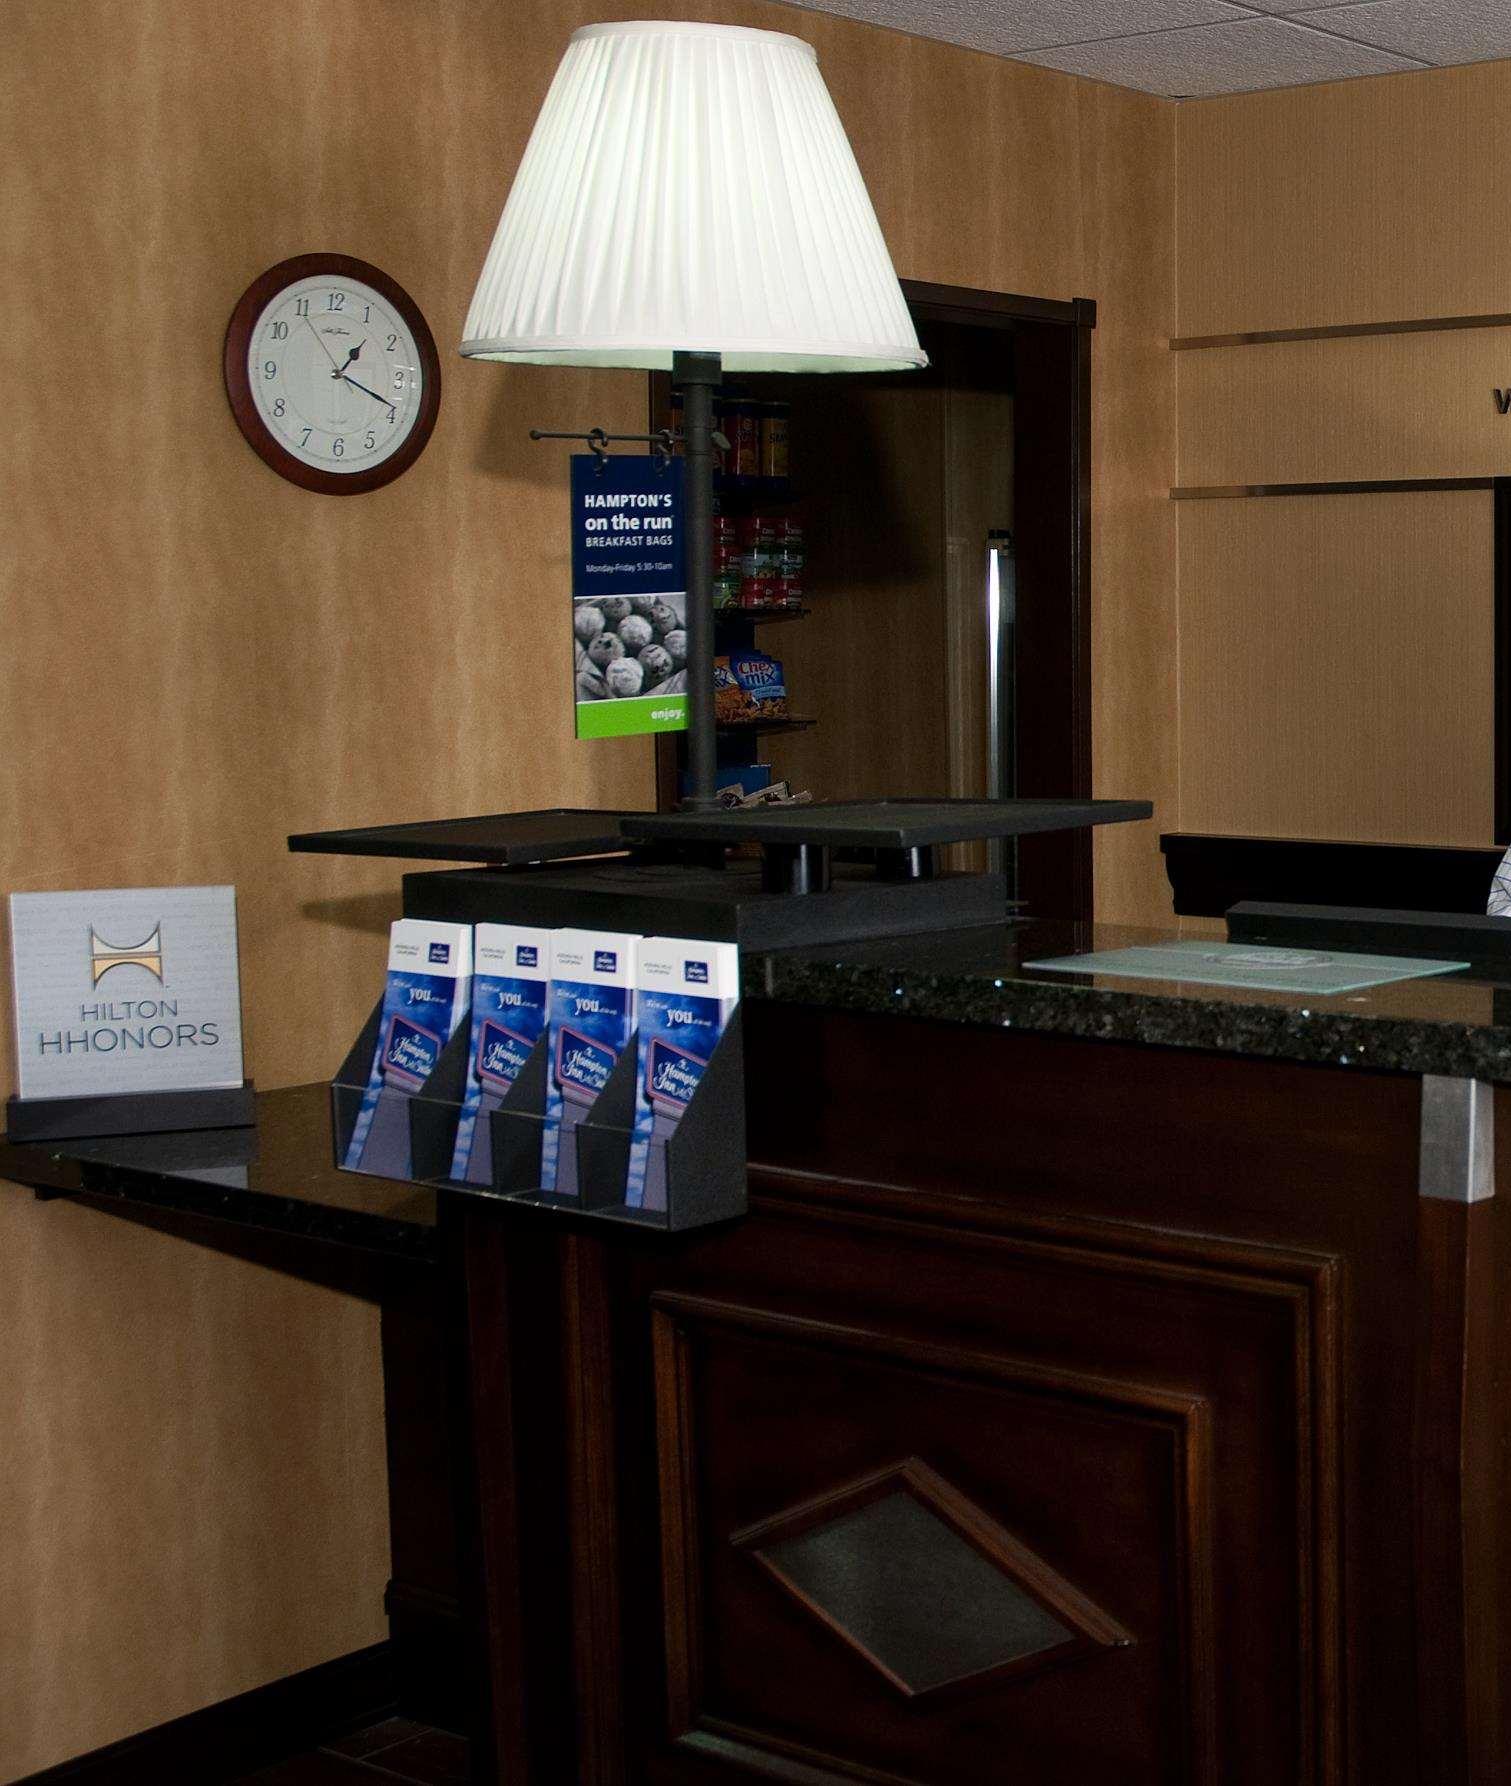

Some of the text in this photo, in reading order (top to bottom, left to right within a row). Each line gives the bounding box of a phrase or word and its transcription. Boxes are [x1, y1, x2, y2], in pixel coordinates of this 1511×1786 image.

[295, 299, 310, 317] 11
[327, 292, 345, 312] 12
[363, 306, 371, 323] 1
[270, 321, 288, 340] 10
[386, 334, 397, 352] 2
[264, 361, 277, 380] 9
[394, 372, 405, 390] 3
[273, 398, 286, 417] 8
[386, 407, 396, 424] 4
[301, 428, 312, 447] 7
[364, 431, 376, 449] 5
[332, 438, 345, 457] 6
[584, 494, 672, 508] HAMPTON'S
[585, 513, 672, 531] on the run
[585, 535, 673, 547] BREAKFAST BAGS
[738, 661, 774, 675] Chex
[745, 671, 777, 687] mix
[80, 999, 178, 1022] HILTON
[40, 1022, 220, 1055] HHONORS
